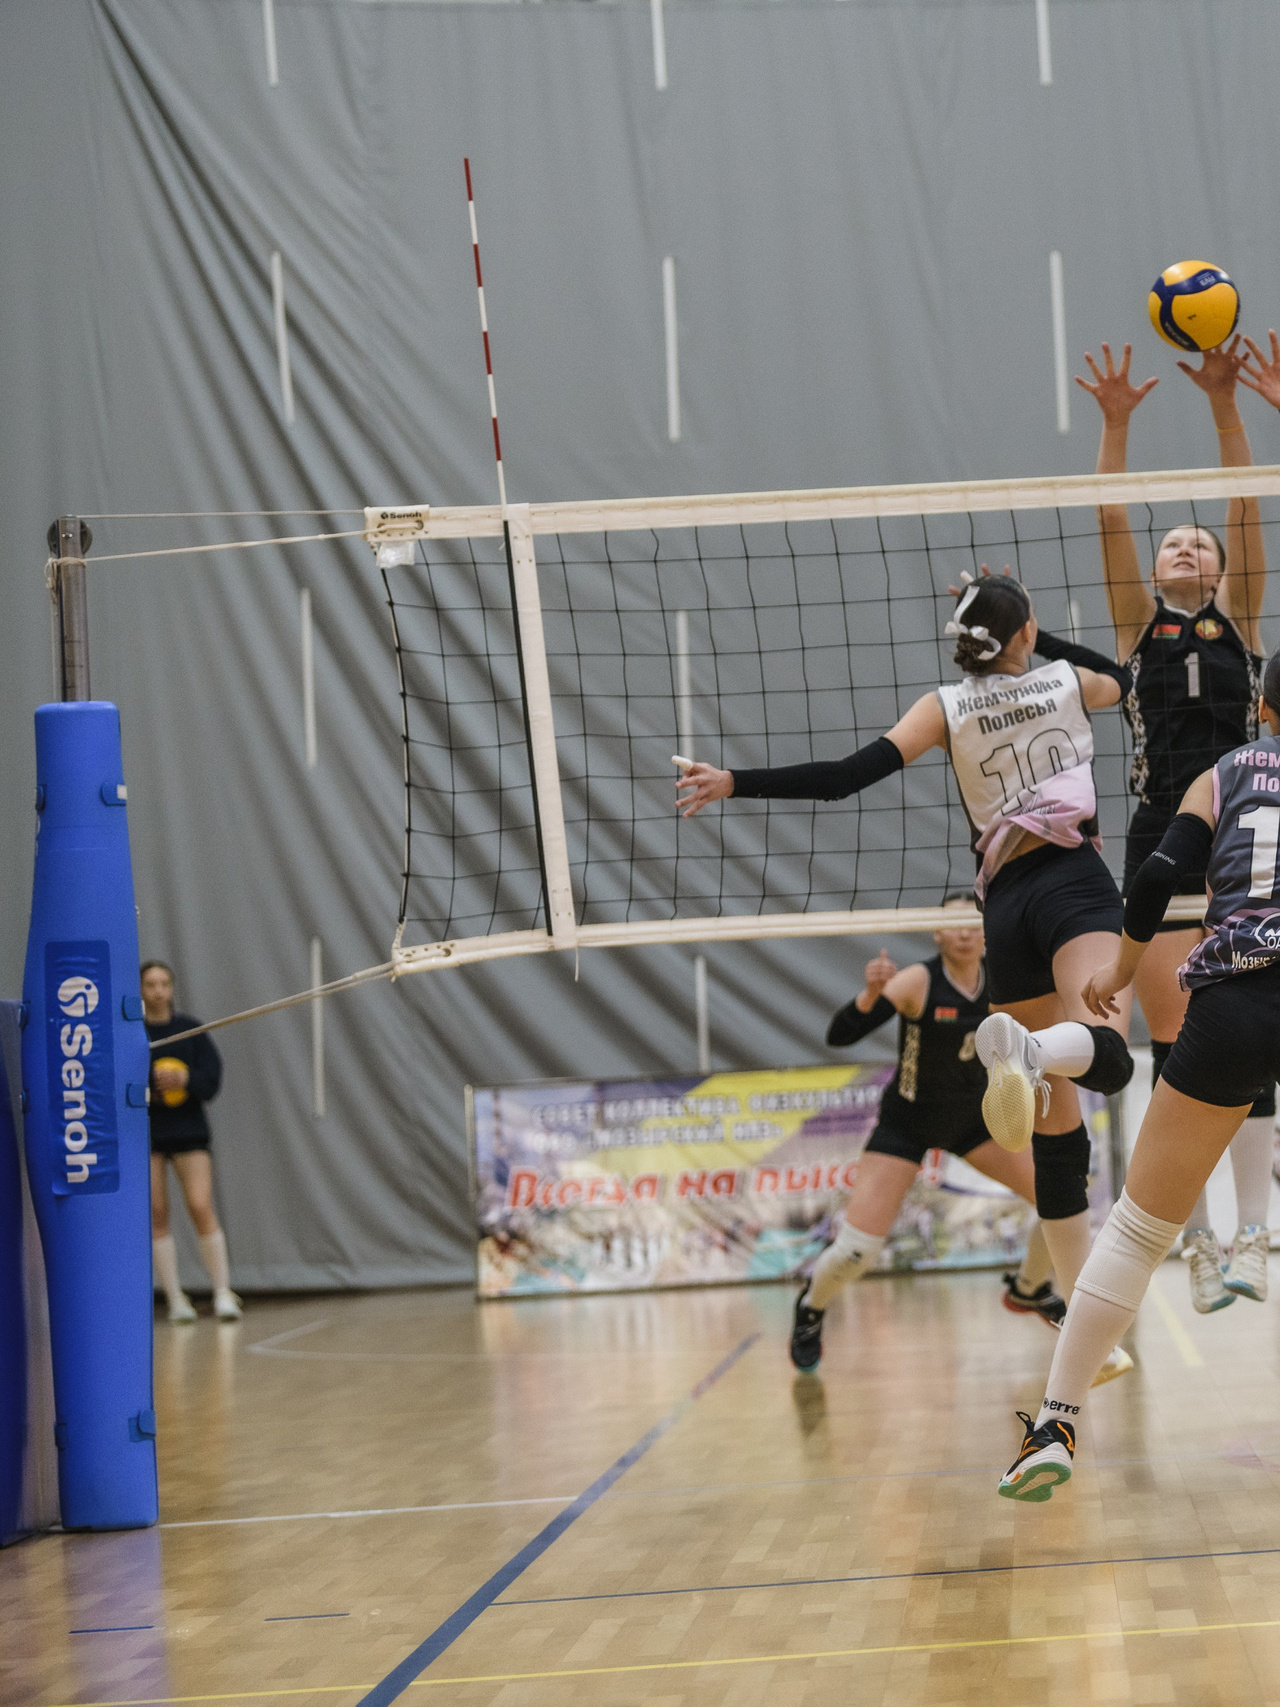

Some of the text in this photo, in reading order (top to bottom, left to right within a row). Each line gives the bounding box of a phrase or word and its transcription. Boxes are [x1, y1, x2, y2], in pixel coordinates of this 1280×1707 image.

[1184, 652, 1200, 697] 1
[977, 699, 1058, 735] Полесья
[979, 728, 1080, 816] 10
[60, 1023, 98, 1183] Senoh
[677, 1170, 737, 1197] на
